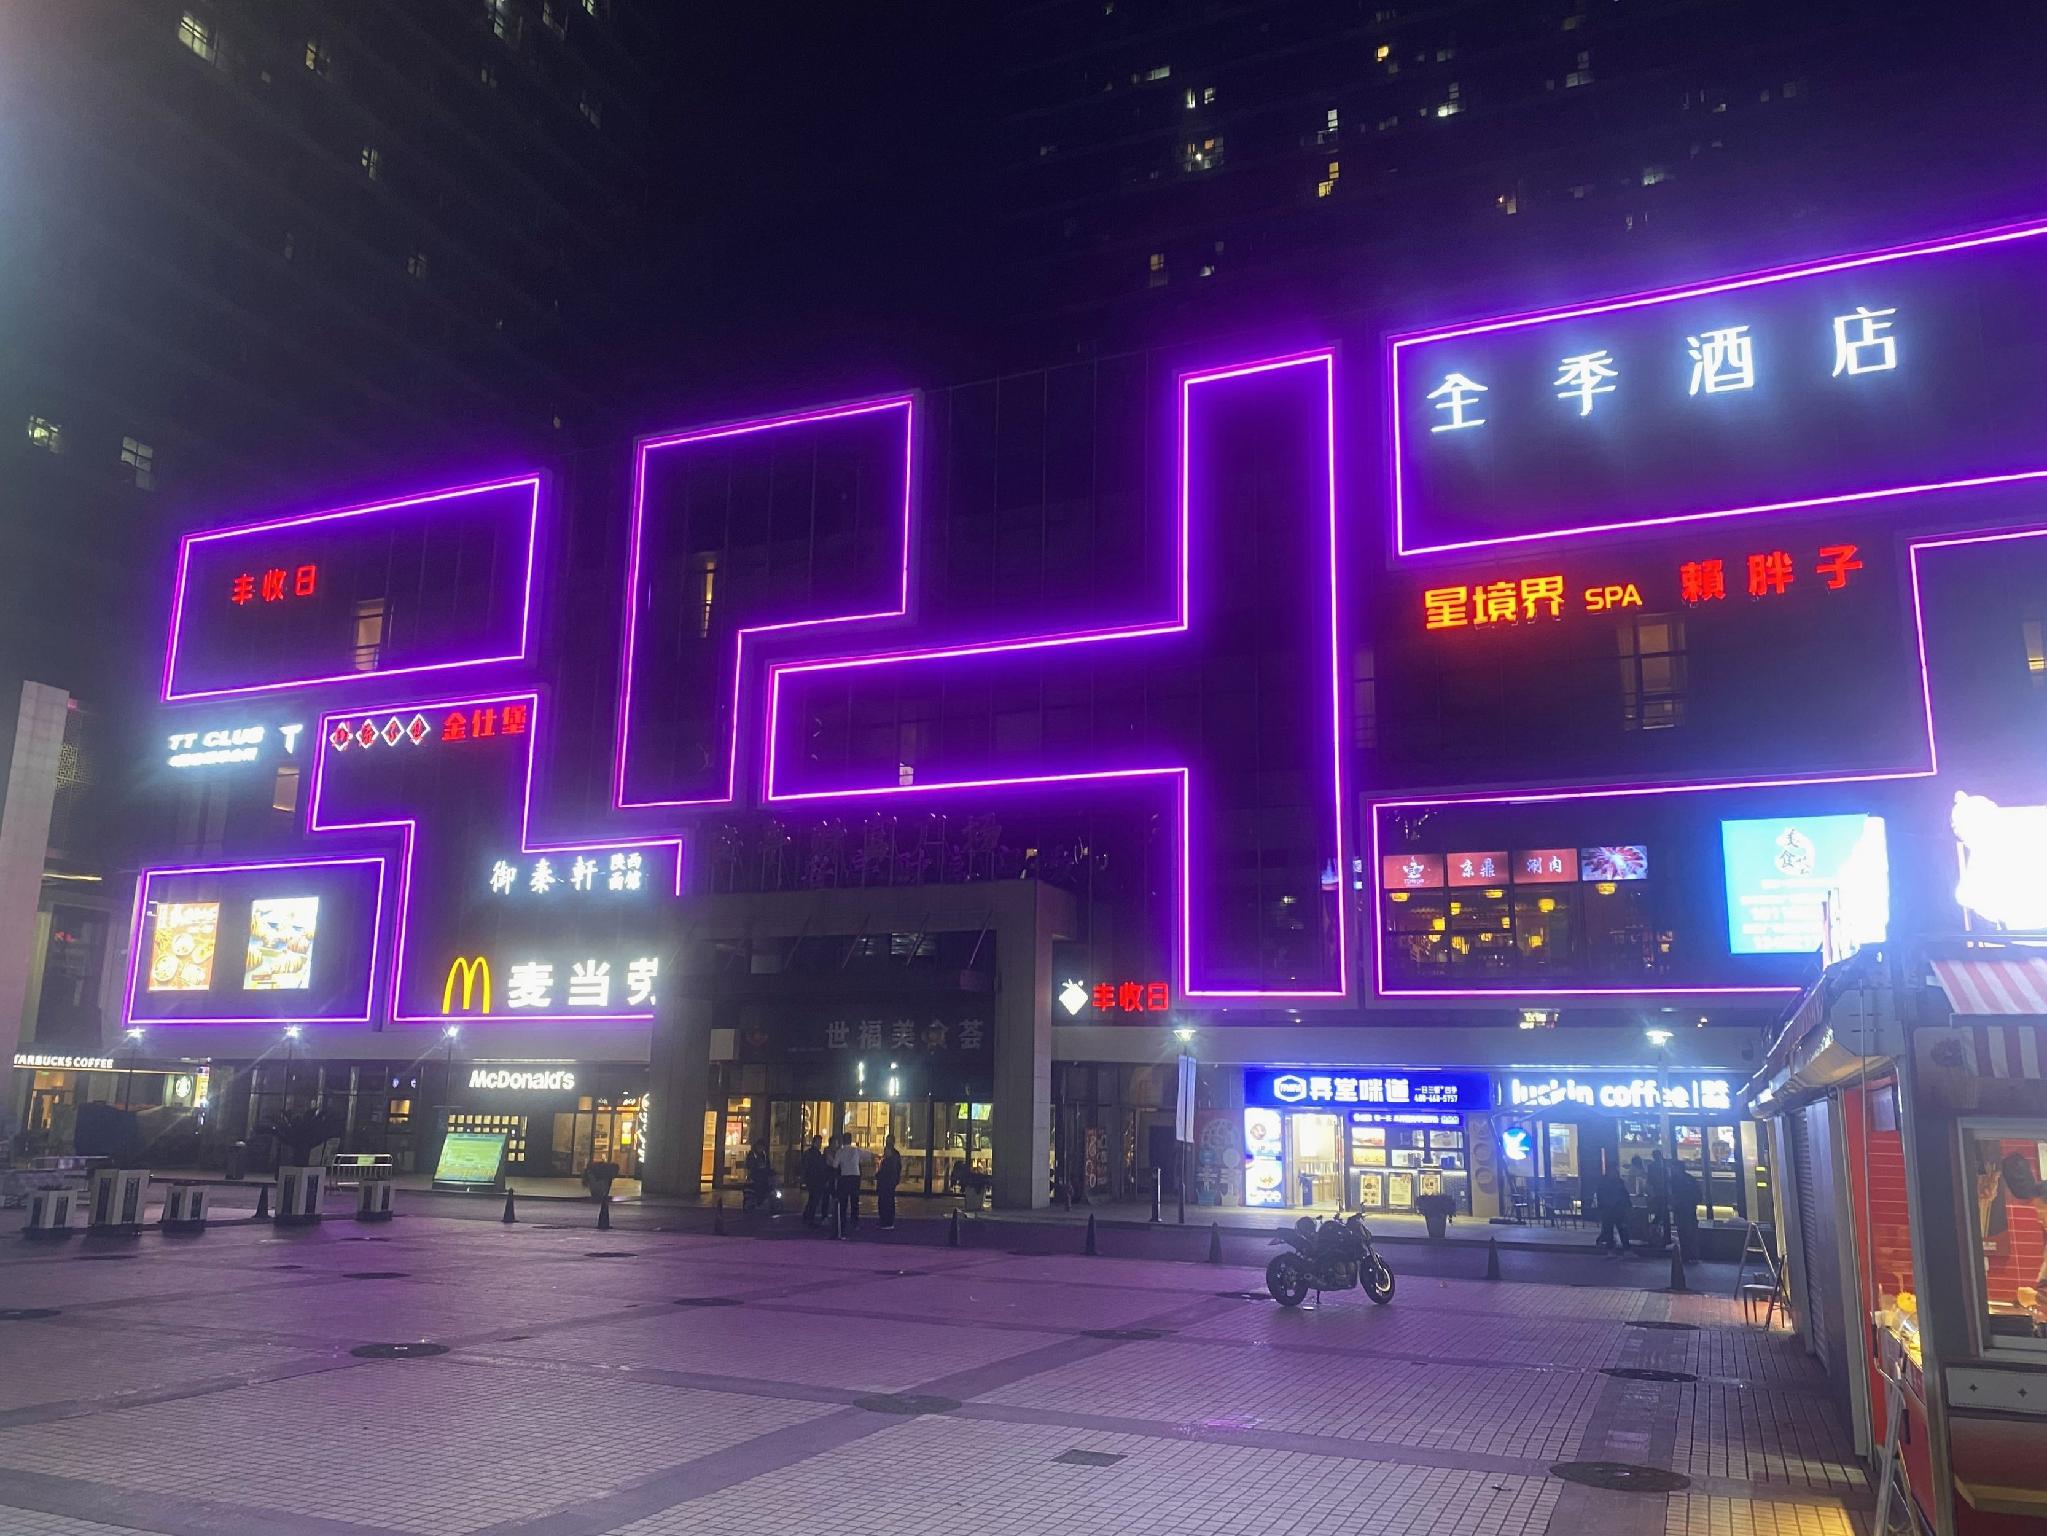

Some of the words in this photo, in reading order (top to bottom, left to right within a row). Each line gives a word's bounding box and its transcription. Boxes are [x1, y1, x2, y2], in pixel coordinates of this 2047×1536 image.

[1427, 306, 1898, 434] 全季酒店
[231, 565, 317, 606] 丰收日
[1423, 574, 1565, 630] 星境界
[1583, 584, 1644, 611] SPA
[1092, 981, 1169, 1012] 丰收日
[73, 1056, 114, 1069] COFFEE
[468, 1069, 576, 1090] McDonald's
